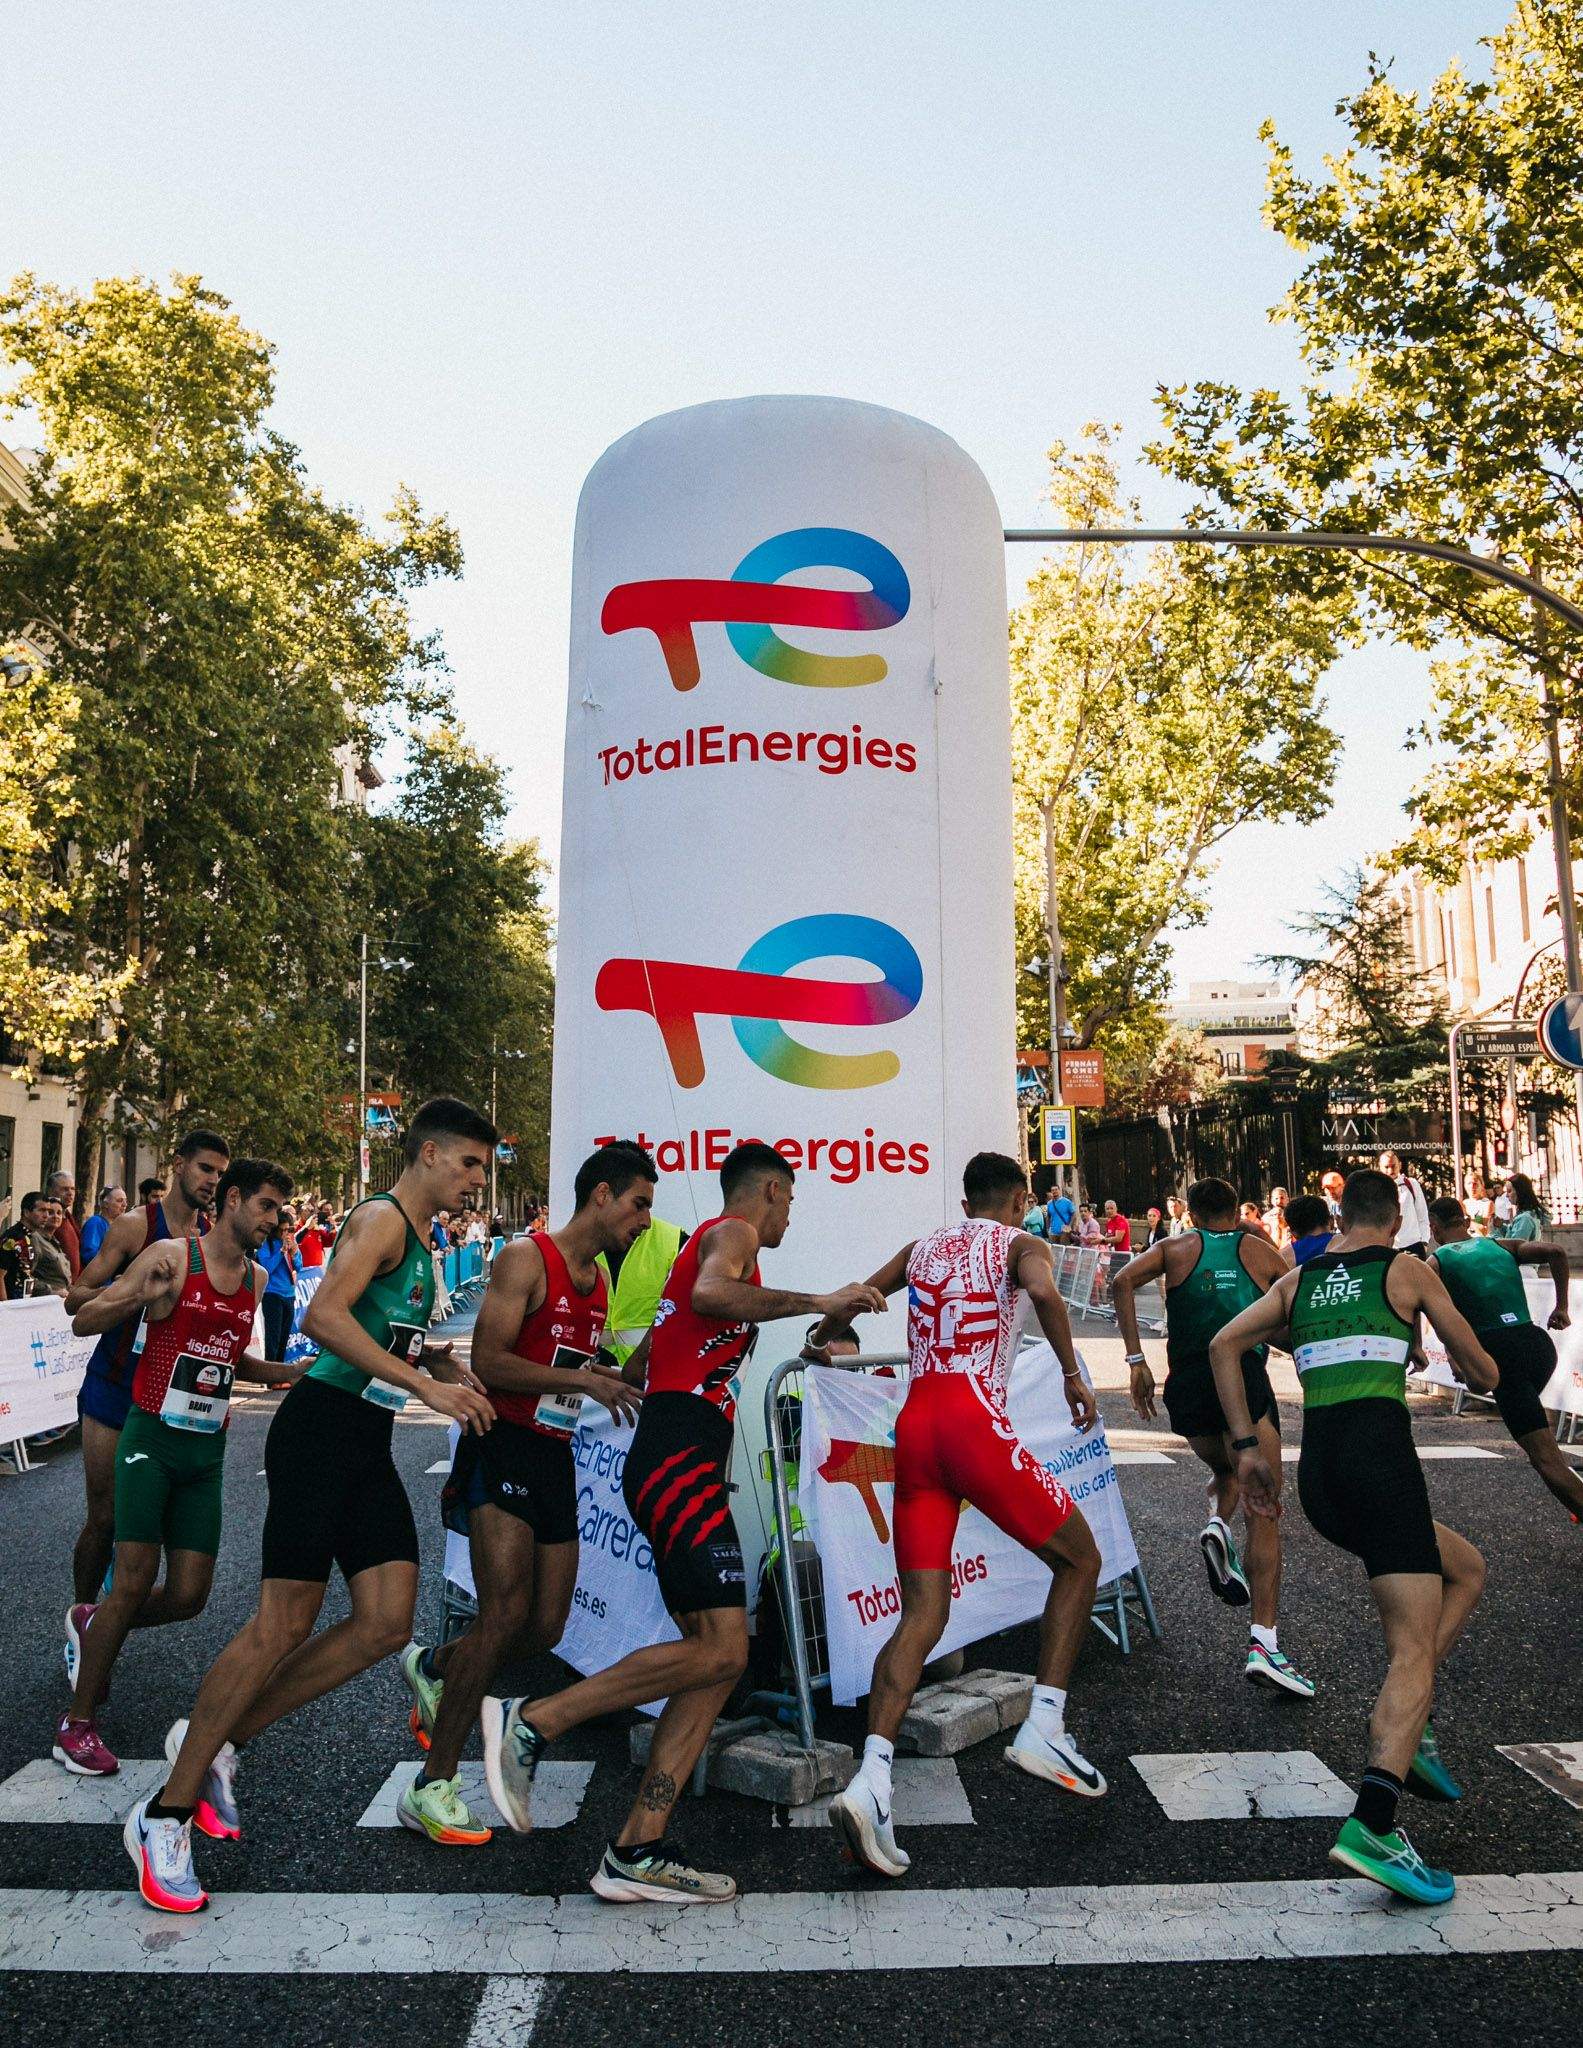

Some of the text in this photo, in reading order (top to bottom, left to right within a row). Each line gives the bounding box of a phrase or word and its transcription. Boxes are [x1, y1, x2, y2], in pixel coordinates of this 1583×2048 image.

[598, 724, 917, 786] TotalEnergies
[1477, 1045, 1486, 1053] LA
[1488, 1044, 1515, 1053] ARMADA
[1321, 1119, 1379, 1137] MAN
[1351, 1142, 1412, 1151] ARQUEOLÓGICO
[1413, 1142, 1454, 1150] NACIONAL
[1311, 1279, 1363, 1300] AIRE
[1310, 1294, 1361, 1309] SPORT
[209, 1334, 232, 1348] Patria
[189, 1400, 213, 1413] BRAVO
[555, 1393, 566, 1406] DE
[1069, 1481, 1091, 1501] tus
